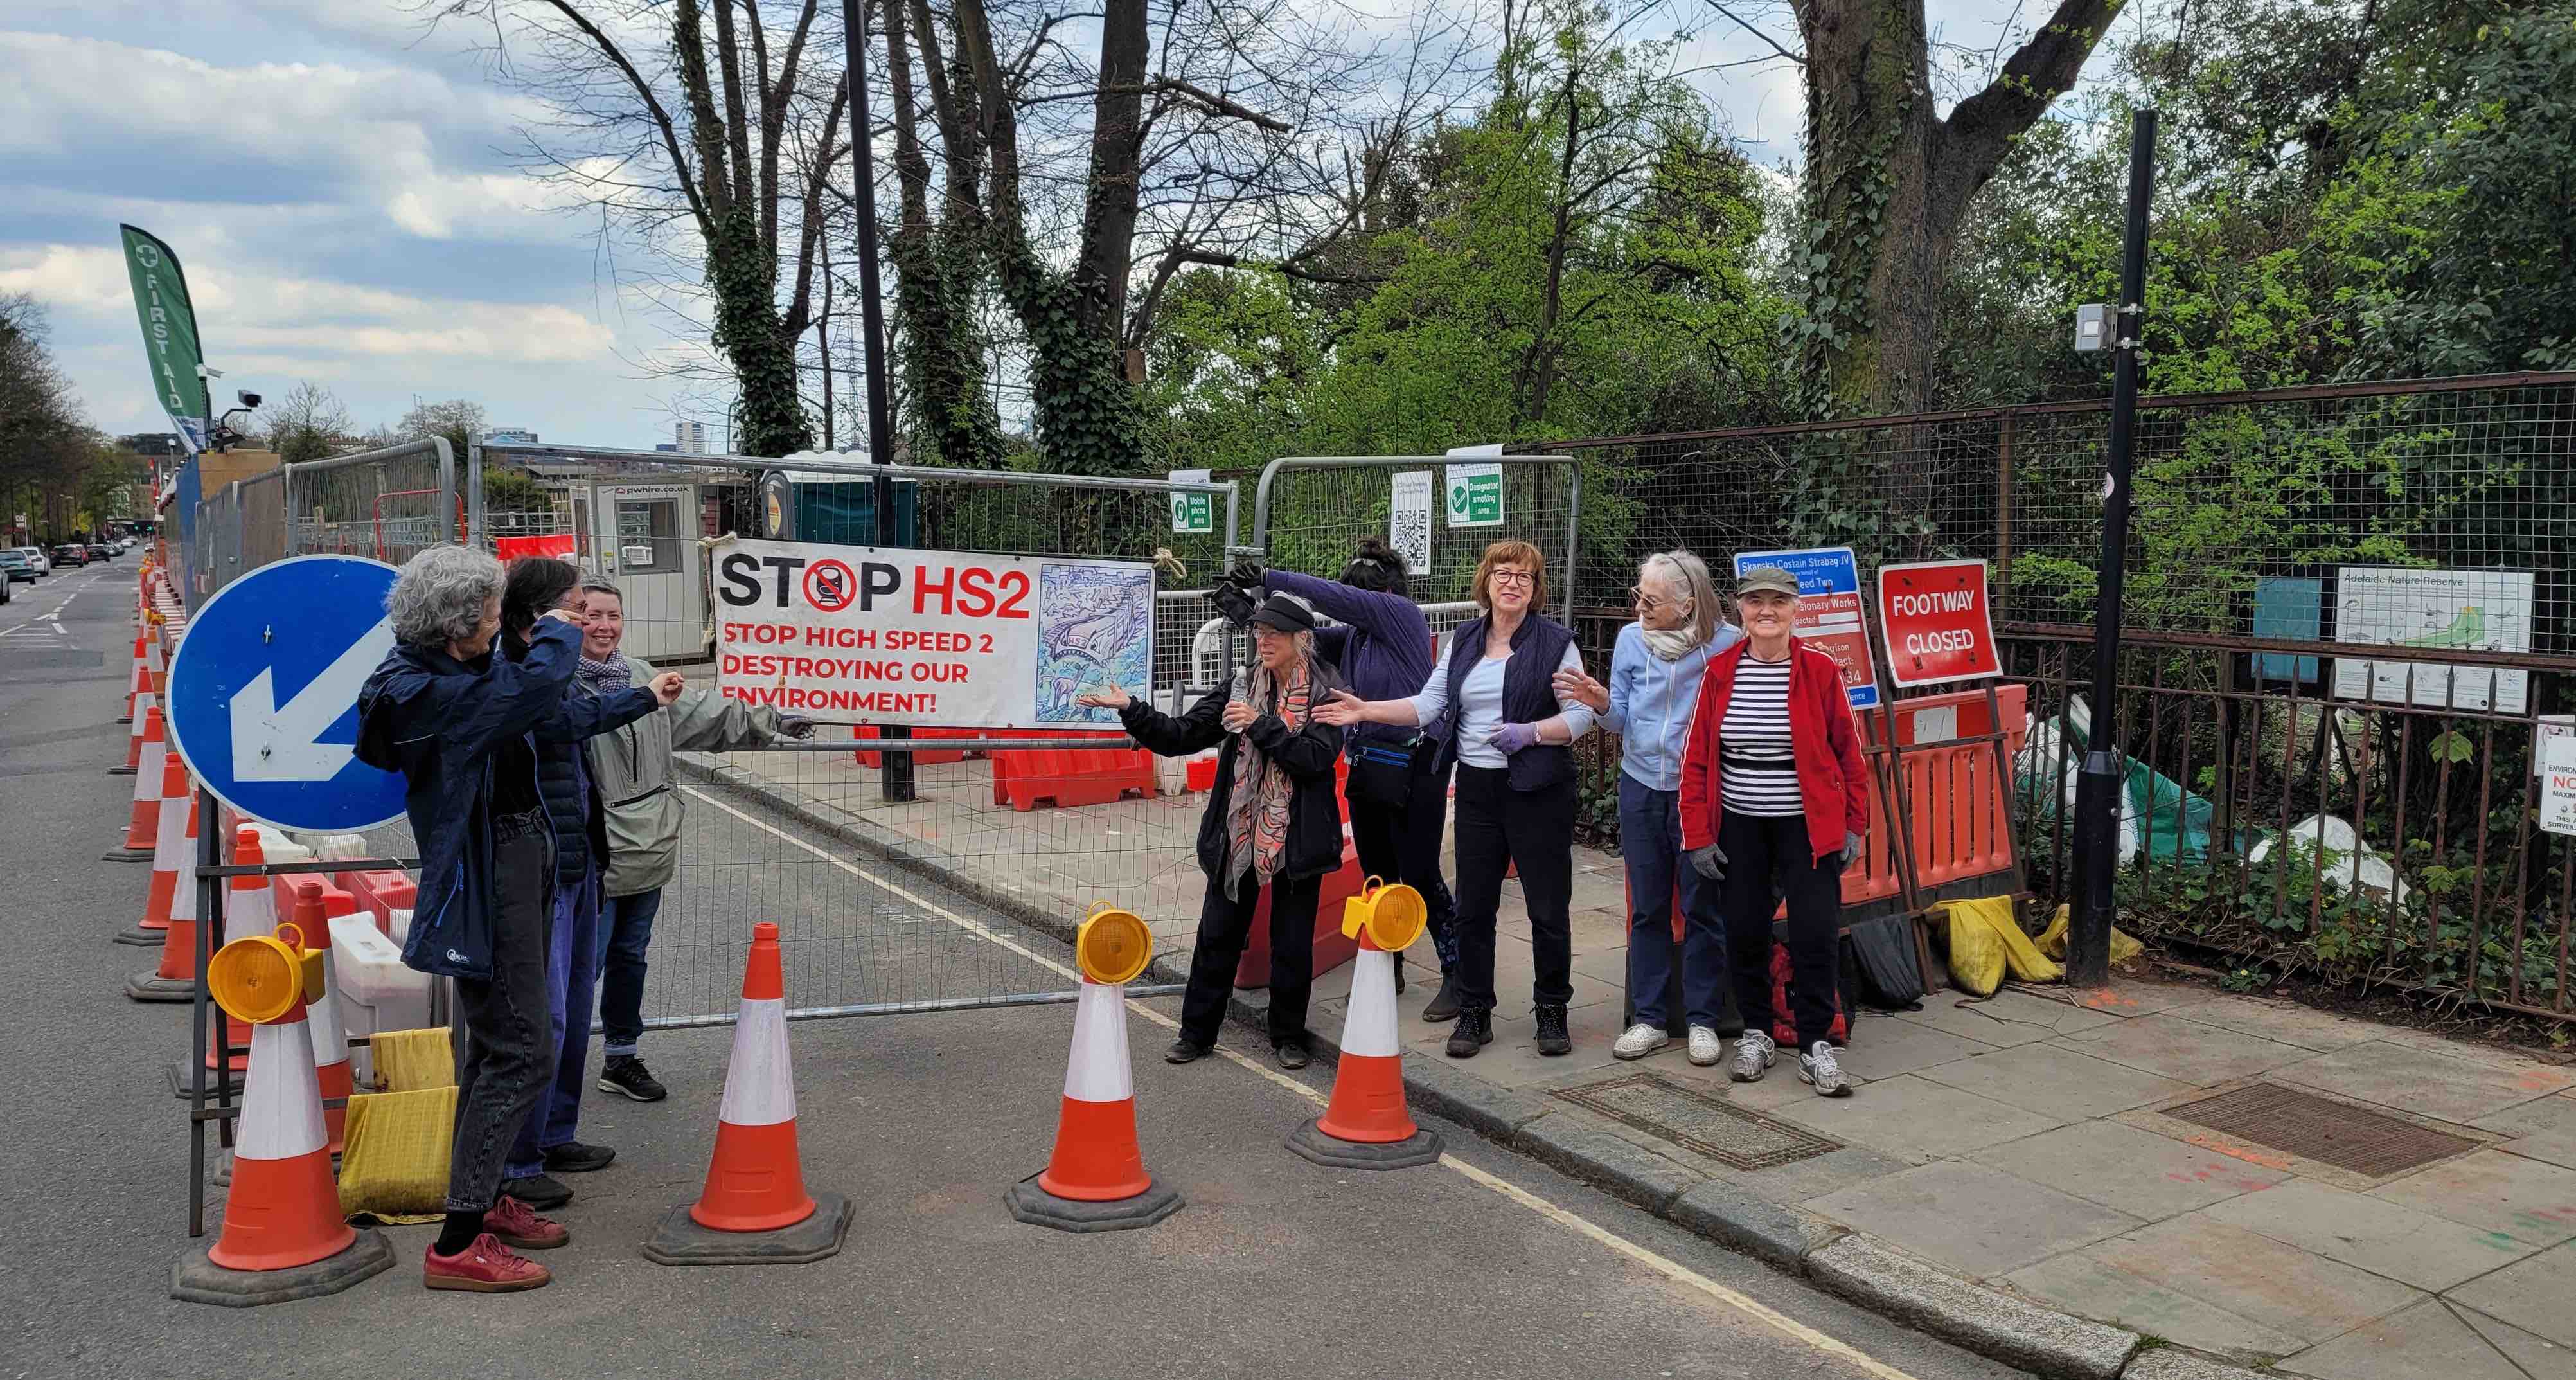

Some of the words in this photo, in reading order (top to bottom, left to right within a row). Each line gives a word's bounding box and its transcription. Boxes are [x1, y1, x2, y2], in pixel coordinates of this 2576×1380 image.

[147, 274, 168, 354] FIRST
[164, 363, 183, 408] AID
[1470, 481, 1499, 492] Designated
[1473, 494, 1496, 504] smoking
[1191, 506, 1206, 516] phone
[1777, 559, 1807, 569] Costain
[1809, 556, 1838, 568] Strabag
[1840, 555, 1849, 566] JV
[719, 553, 901, 613] STOP
[913, 566, 1031, 619] HS2
[1800, 578, 1815, 589] eed
[2345, 574, 2385, 584] Adelaide
[2388, 575, 2421, 585] Nature
[2423, 576, 2464, 586] Reserve
[1799, 601, 1829, 611] sionary
[1831, 598, 1856, 608] Works
[1893, 590, 1975, 617] FOOTWAY
[724, 622, 797, 645] STOP
[806, 627, 876, 650] HIGH
[884, 630, 972, 653] SPEED
[979, 634, 994, 654] 2
[1906, 629, 1975, 655] CLOSED
[722, 654, 903, 681] DESTROYING
[910, 663, 969, 683] OUR
[722, 686, 937, 713] ENVIRONMENT!
[2549, 765, 2576, 775] ENVIRON
[2552, 791, 2576, 799] MAXIM
[2547, 821, 2576, 830] SURVEIL
